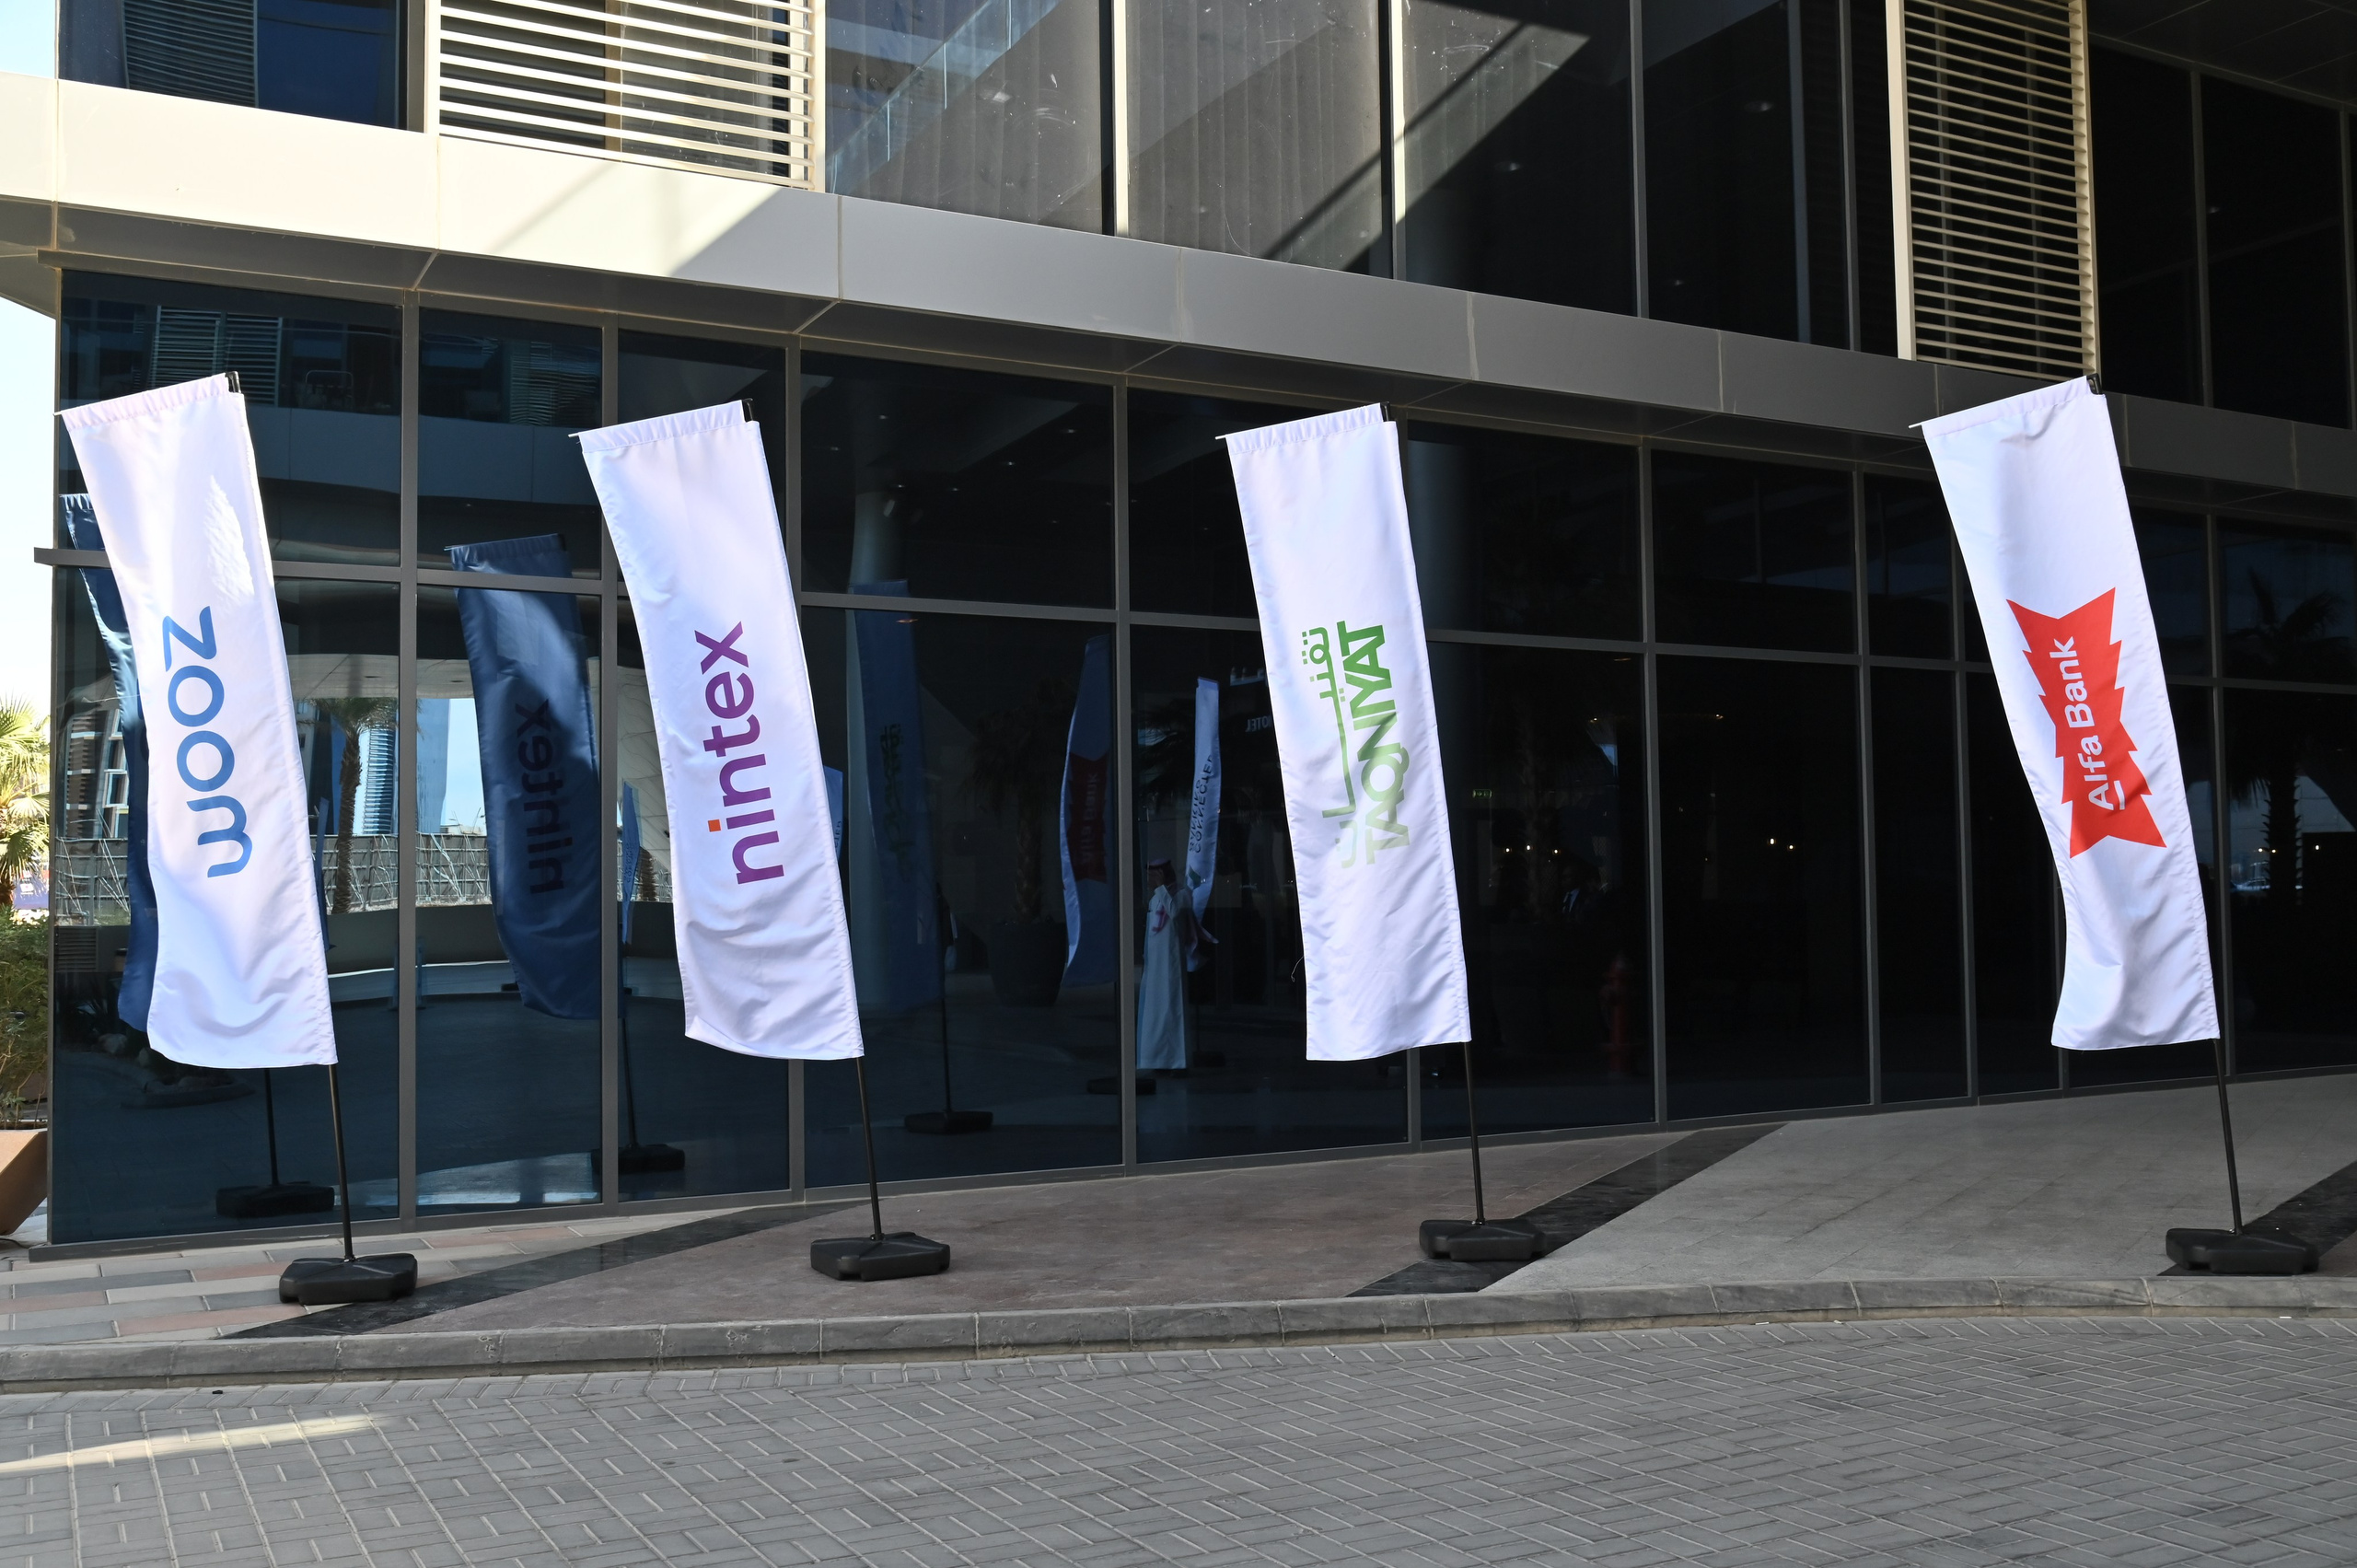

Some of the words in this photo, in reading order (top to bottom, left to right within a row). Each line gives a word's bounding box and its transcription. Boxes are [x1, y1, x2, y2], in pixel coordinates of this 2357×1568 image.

[162, 605, 253, 877] wooz
[694, 621, 784, 885] nintex
[1336, 620, 1410, 865] TAQNIYAT
[2049, 635, 2096, 728] Bank
[2077, 734, 2117, 811] Alfa
